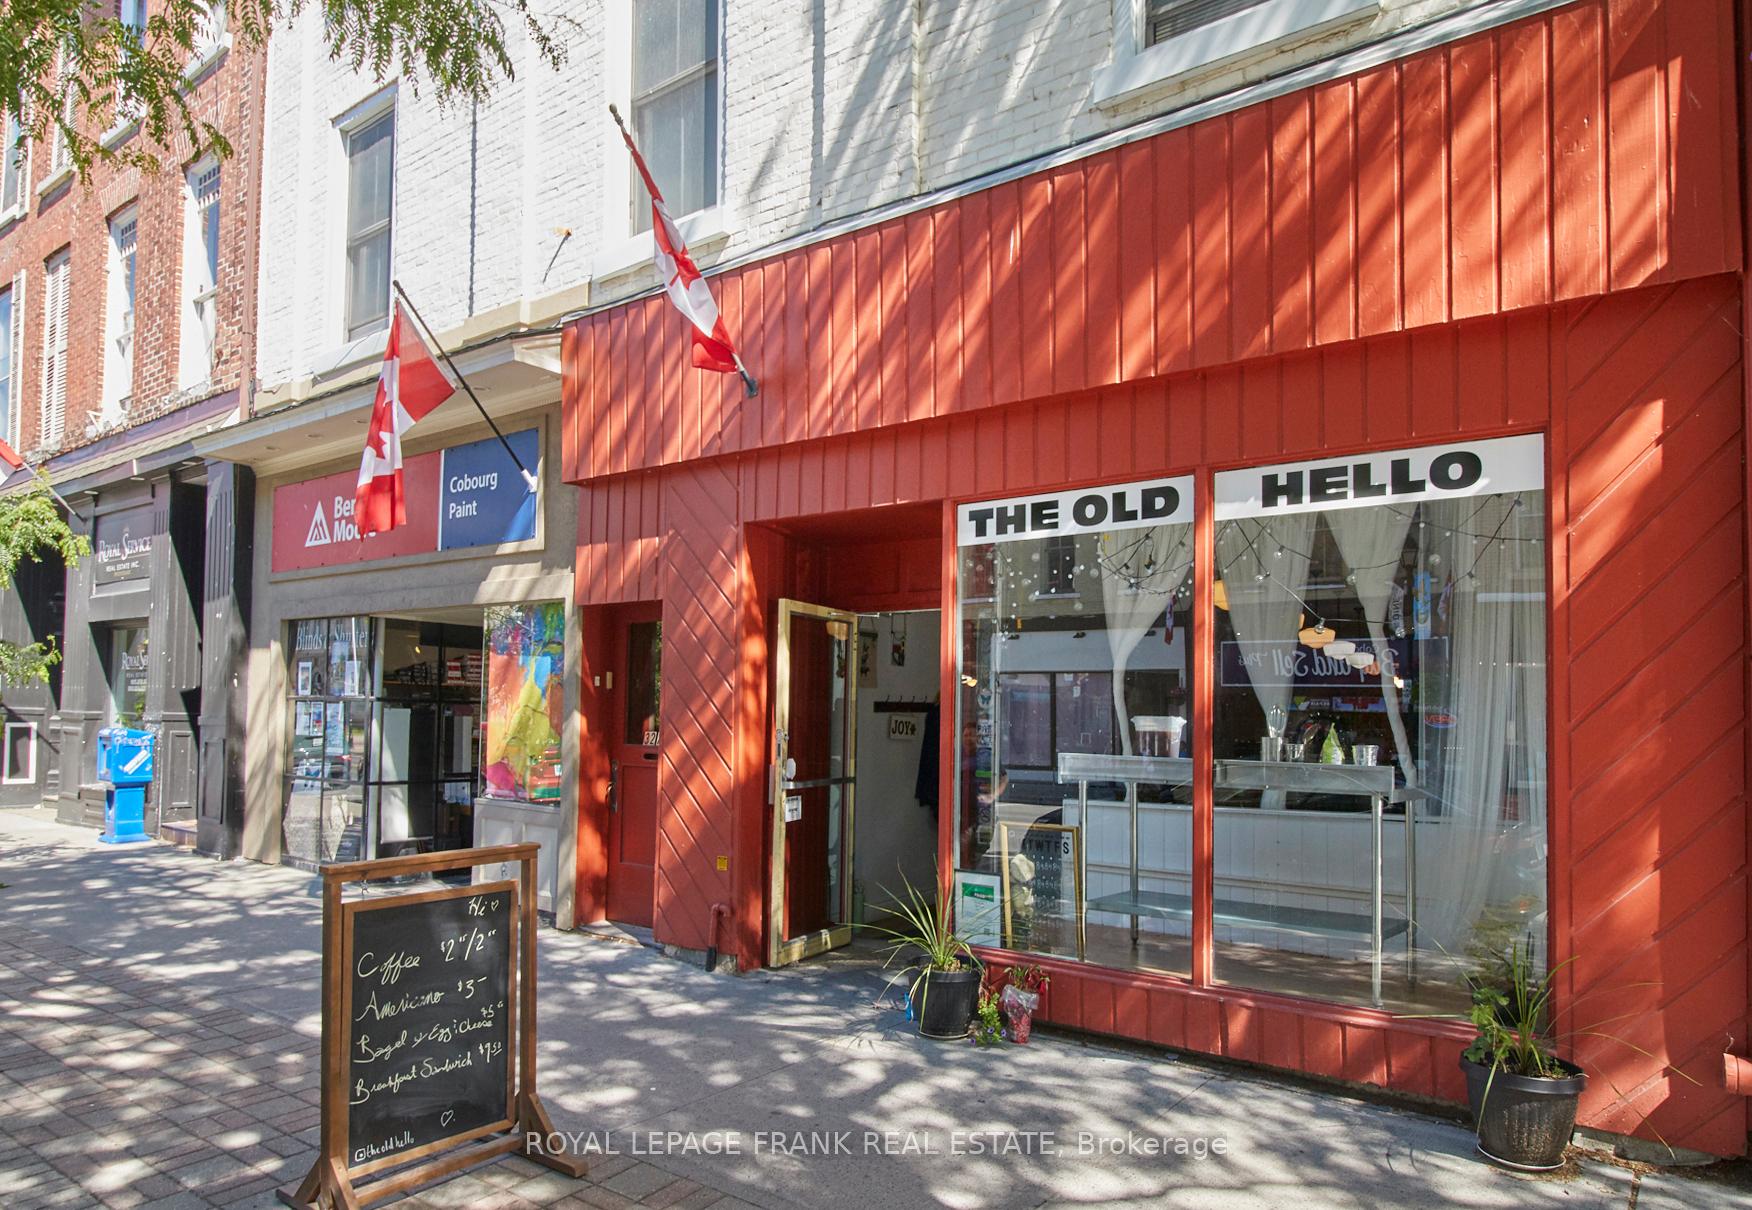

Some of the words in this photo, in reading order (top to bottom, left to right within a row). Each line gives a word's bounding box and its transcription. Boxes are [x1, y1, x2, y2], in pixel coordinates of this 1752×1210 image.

[449, 471, 498, 495] Cobourg
[1261, 451, 1482, 508] HELLO
[449, 501, 478, 520] Paint
[968, 499, 1060, 538] THE
[1071, 485, 1180, 527] OLD
[644, 731, 660, 746] 32
[891, 719, 911, 736] JOY
[357, 952, 422, 985] Coffee
[353, 1030, 408, 1063] Bagel
[349, 1064, 417, 1105] Breakfast
